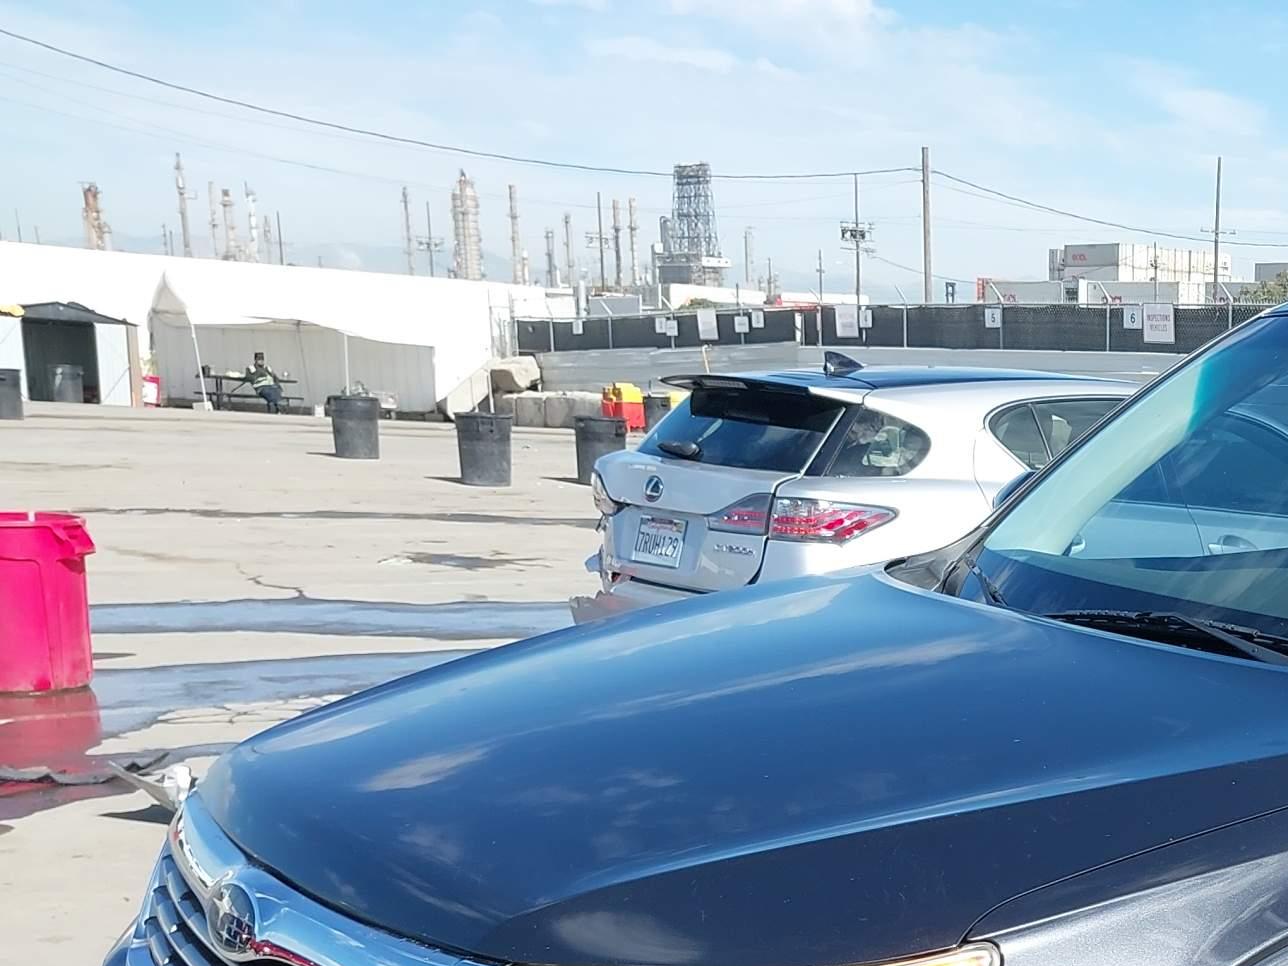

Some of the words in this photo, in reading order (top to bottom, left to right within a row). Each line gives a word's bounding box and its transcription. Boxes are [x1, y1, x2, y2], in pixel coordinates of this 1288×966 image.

[991, 313, 996, 323] 5
[1130, 312, 1136, 324] 6
[638, 530, 680, 558] 7RUH129
